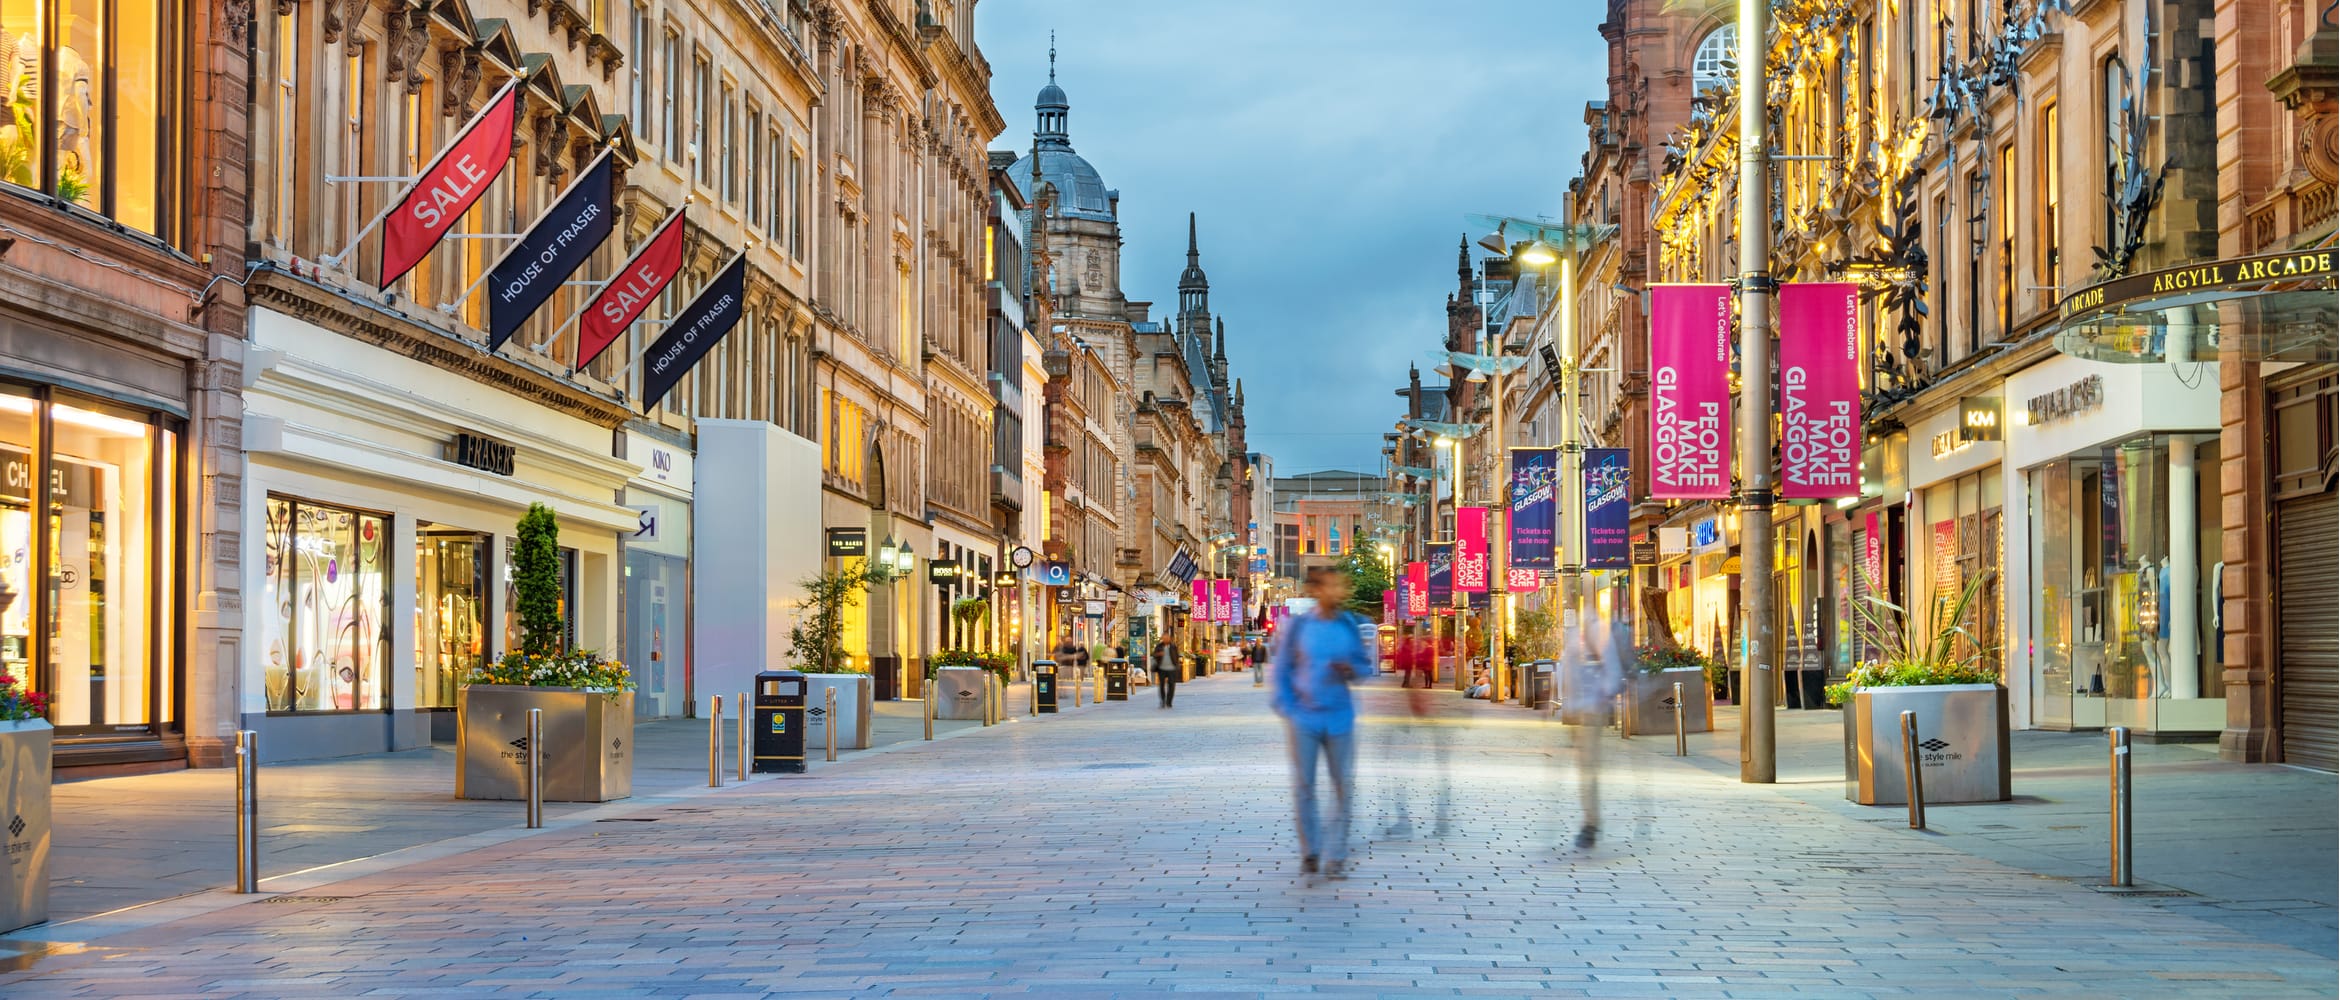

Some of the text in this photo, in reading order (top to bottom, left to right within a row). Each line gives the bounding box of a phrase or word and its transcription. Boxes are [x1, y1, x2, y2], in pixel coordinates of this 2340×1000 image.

[413, 153, 487, 229] SALE
[501, 203, 601, 303] HOUSE OF FRASER
[2153, 253, 2331, 293] ARGYLL ARCADE
[602, 264, 662, 324] SALE
[2071, 287, 2104, 311] ARCADE
[651, 294, 734, 376] HOUSE OF FRASER
[1717, 296, 1727, 362] Let's Celebrate
[1846, 294, 1856, 360] Let's Celebrate
[1656, 366, 1677, 486] GLASGOW
[1786, 366, 1808, 485] GLASGOW
[1830, 400, 1851, 485] PEOPLE
[1967, 410, 1995, 427] KM
[459, 434, 516, 476] FRASERS
[653, 448, 671, 472] KIKO
[1678, 420, 1698, 486] MAKE
[1699, 401, 1719, 486] PEOPLE
[1808, 419, 1829, 486] MAKE
[1514, 484, 1551, 512] GLASGOW
[1588, 484, 1624, 512] GLASGOW
[1457, 539, 1467, 587] GLASGOW
[1466, 560, 1475, 587] MAKE
[1474, 553, 1484, 587] PEOPLE
[1518, 569, 1526, 587] AKE
[501, 751, 513, 759] the
[1925, 752, 1962, 761] style mile
